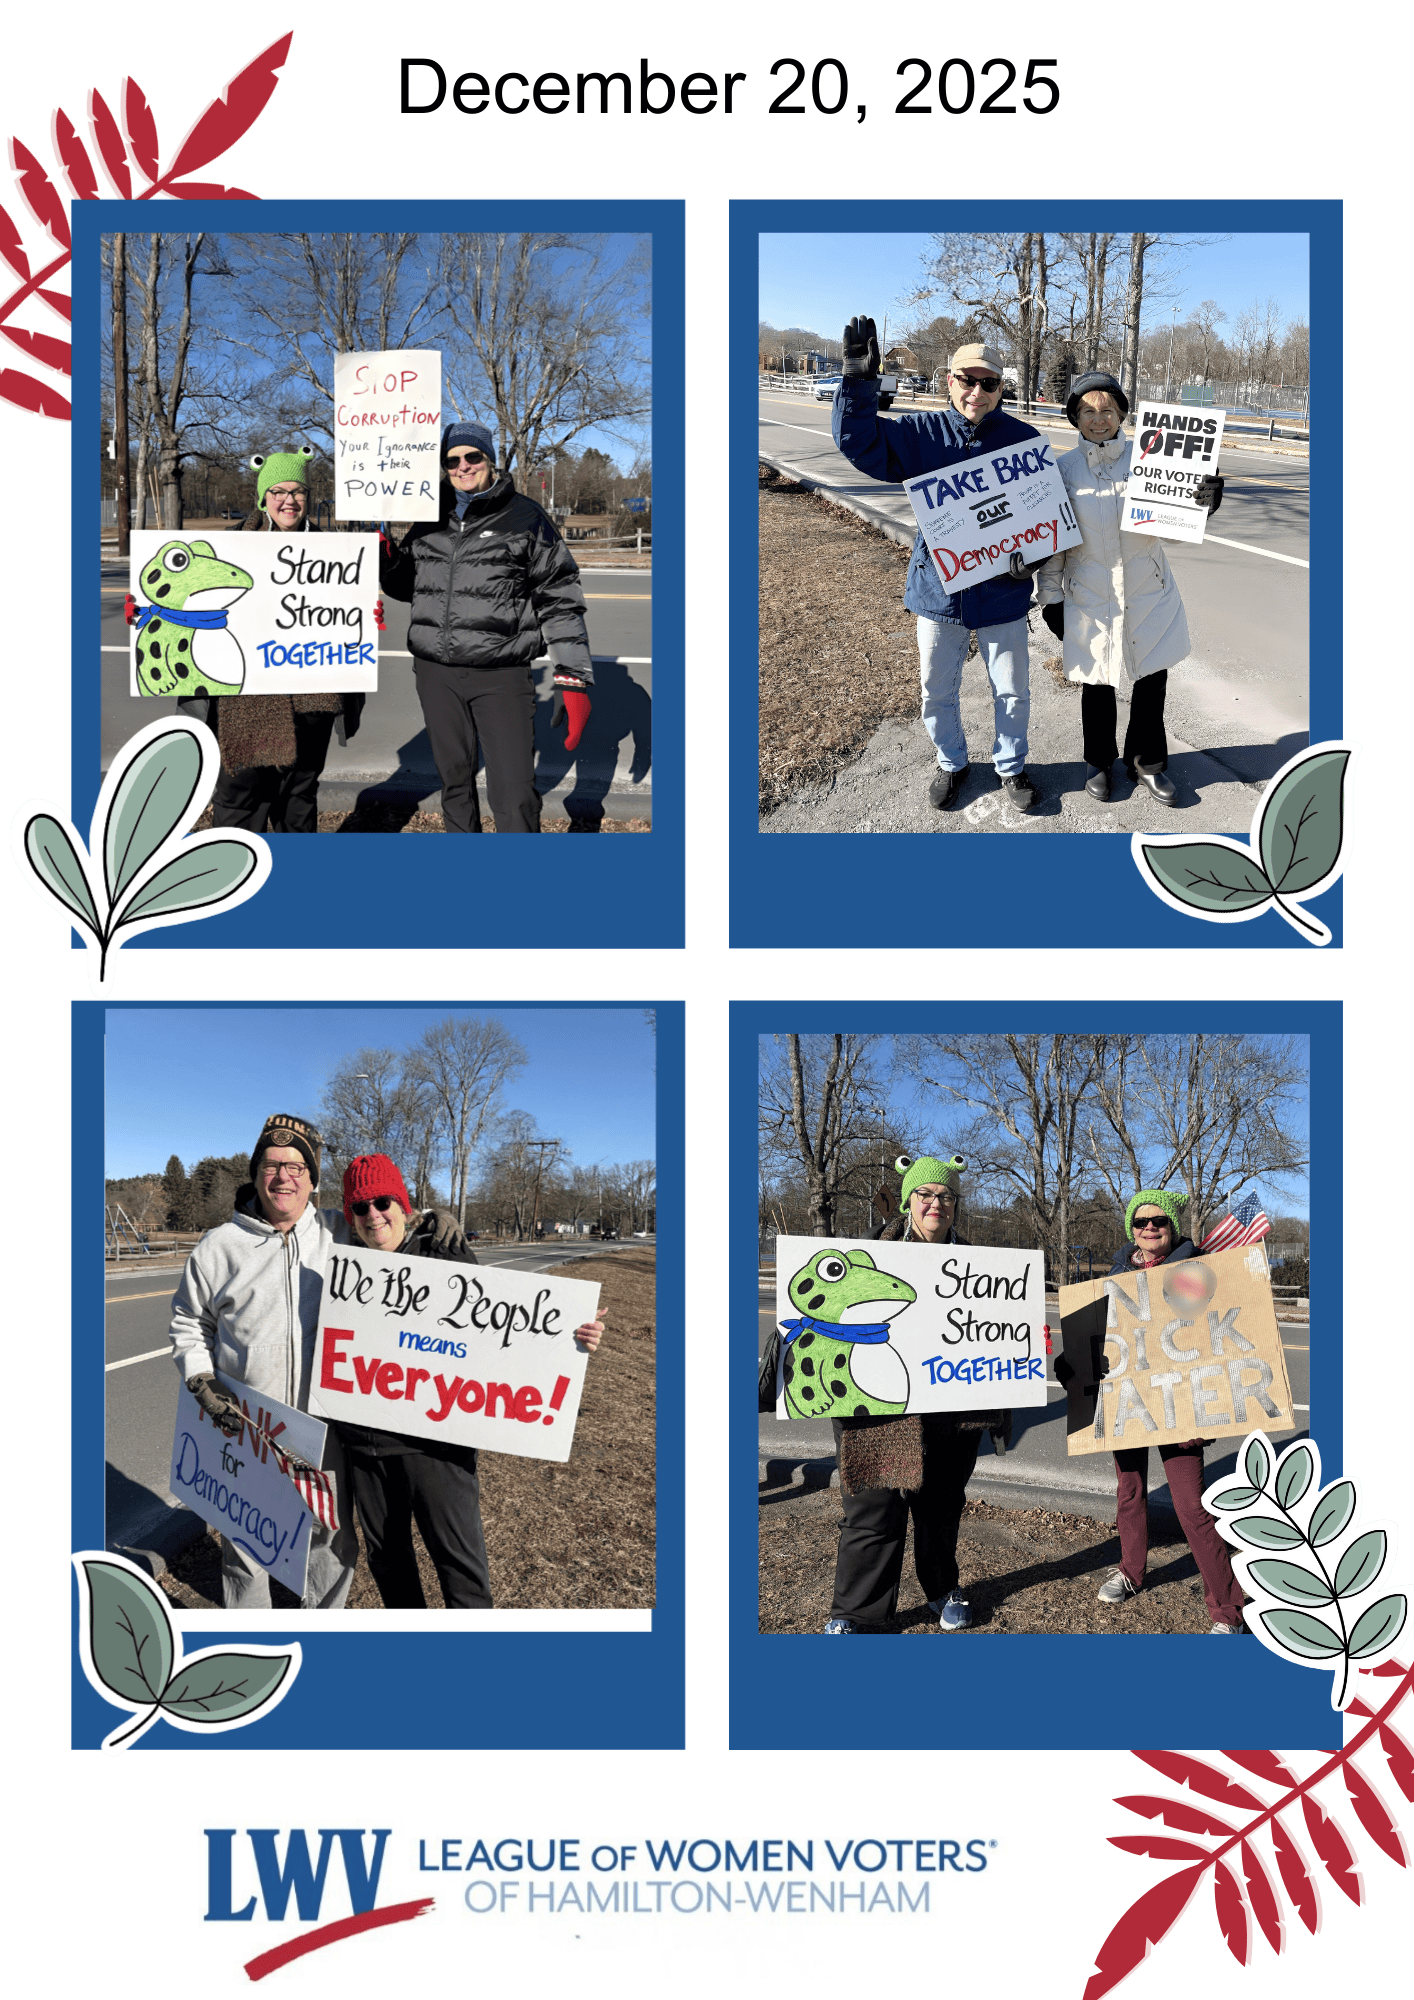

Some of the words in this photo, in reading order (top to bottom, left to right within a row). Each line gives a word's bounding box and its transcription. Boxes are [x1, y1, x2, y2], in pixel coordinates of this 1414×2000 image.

[1142, 412, 1218, 435] HANDS
[1139, 429, 1215, 462] OFF!
[352, 461, 365, 472] is
[909, 468, 990, 510] TAKE
[991, 444, 1055, 486] BACK
[1133, 465, 1163, 480] OUR
[1165, 469, 1203, 485] VOTE
[344, 479, 435, 501] POWER
[1144, 481, 1194, 499] RIGHTS
[977, 500, 1011, 523] our
[1130, 508, 1154, 521] LWV
[1157, 519, 1178, 527] WOMEN
[270, 545, 365, 586] Stand
[275, 593, 363, 650] Strong
[256, 640, 377, 669] TOGETHER
[934, 1258, 1031, 1301] Stand
[1103, 1261, 1218, 1329] N
[328, 1254, 374, 1306] We
[378, 1266, 430, 1317] the
[437, 1273, 563, 1350] People
[399, 1330, 467, 1359] means
[941, 1307, 1031, 1365] Strong
[1090, 1307, 1256, 1381] DICK
[320, 1327, 571, 1426] Everyone!
[921, 1355, 1045, 1385] TOGETHER
[1084, 1357, 1283, 1439] TATER
[200, 1397, 288, 1474] NK
[219, 1442, 245, 1478] for
[176, 1431, 306, 1566] Democracy!
